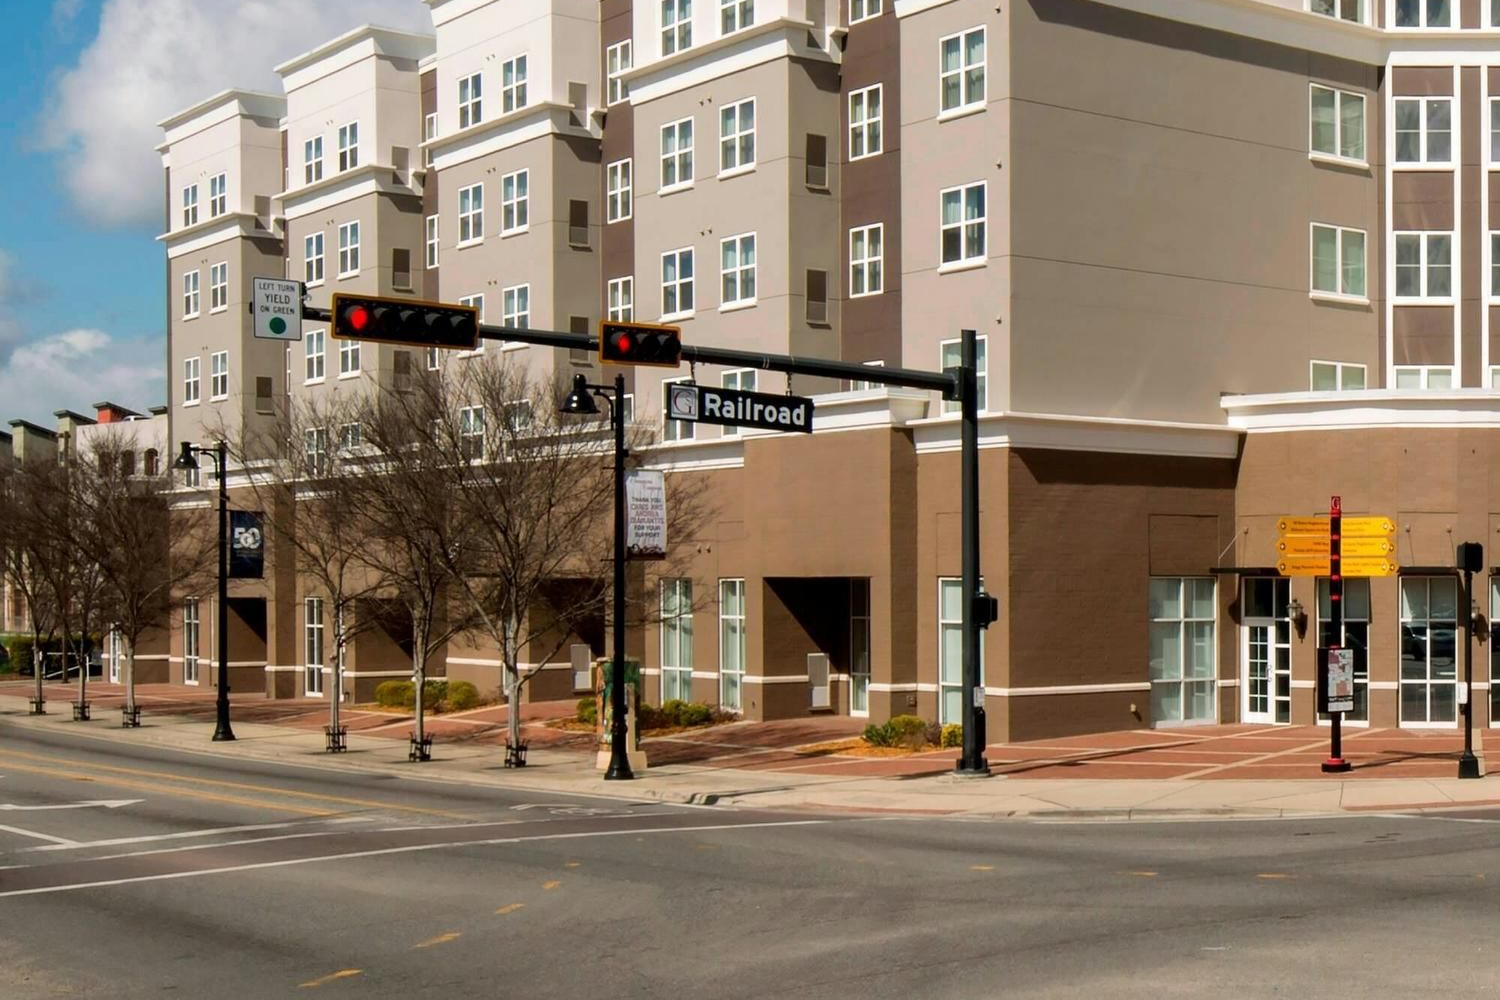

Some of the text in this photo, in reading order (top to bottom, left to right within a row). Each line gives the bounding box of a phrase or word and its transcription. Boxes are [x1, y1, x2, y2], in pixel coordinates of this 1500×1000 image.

[259, 282, 295, 292] LEFT TURN
[265, 293, 290, 304] YIELD
[273, 306, 295, 315] GREEN
[704, 392, 805, 426] Railroad
